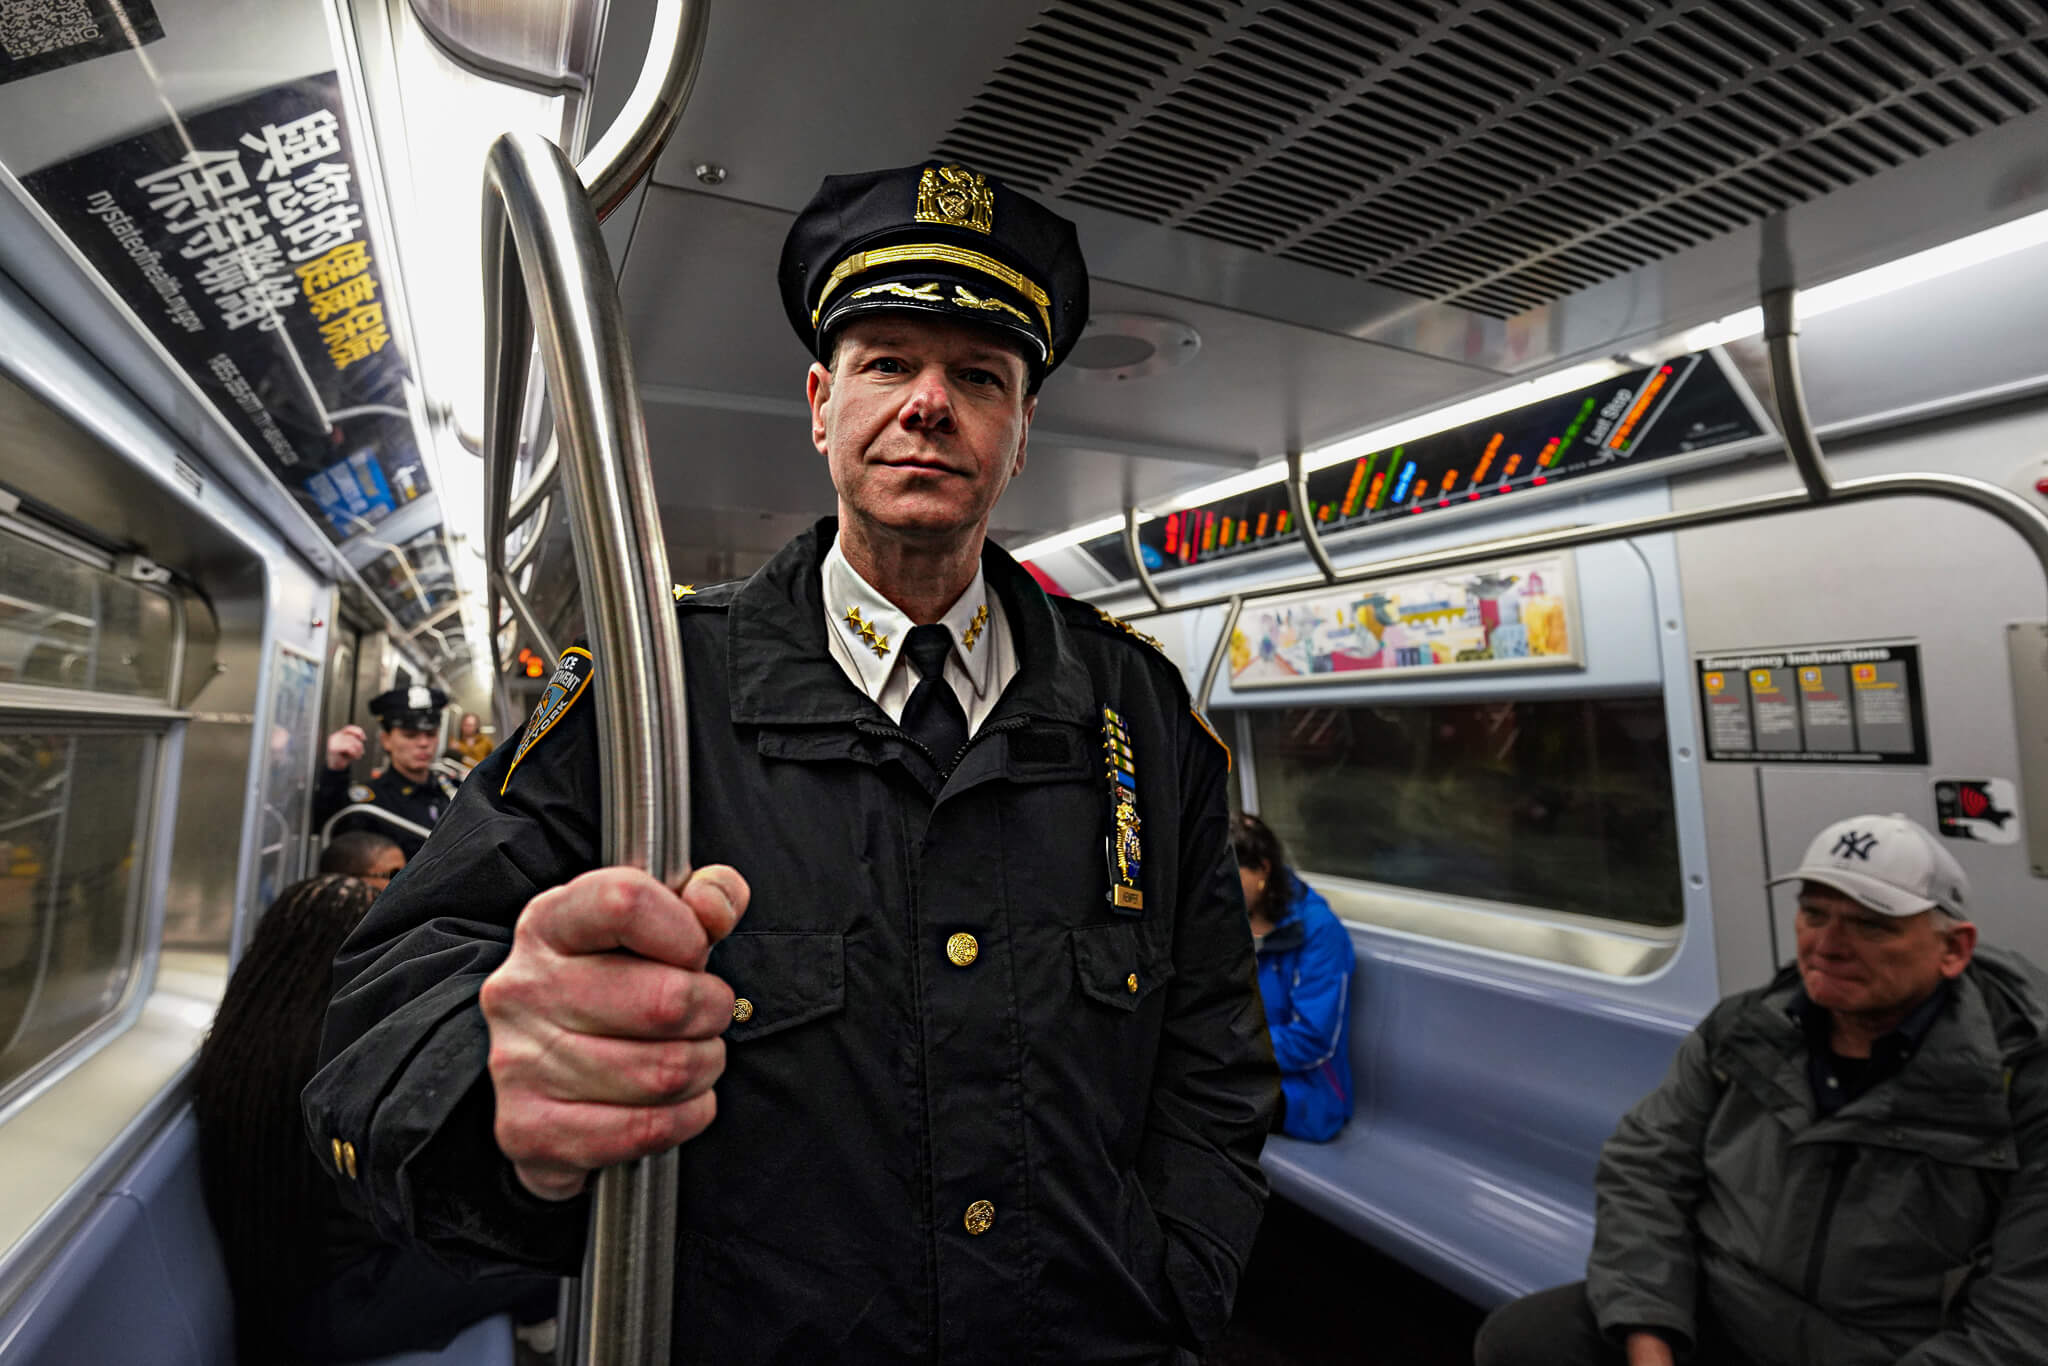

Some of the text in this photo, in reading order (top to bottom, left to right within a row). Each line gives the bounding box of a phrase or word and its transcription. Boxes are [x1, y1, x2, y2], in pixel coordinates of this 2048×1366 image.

[1703, 649, 1890, 670] Emergency Instructions
[532, 700, 569, 738] YORK
[1830, 831, 1879, 861] NY
